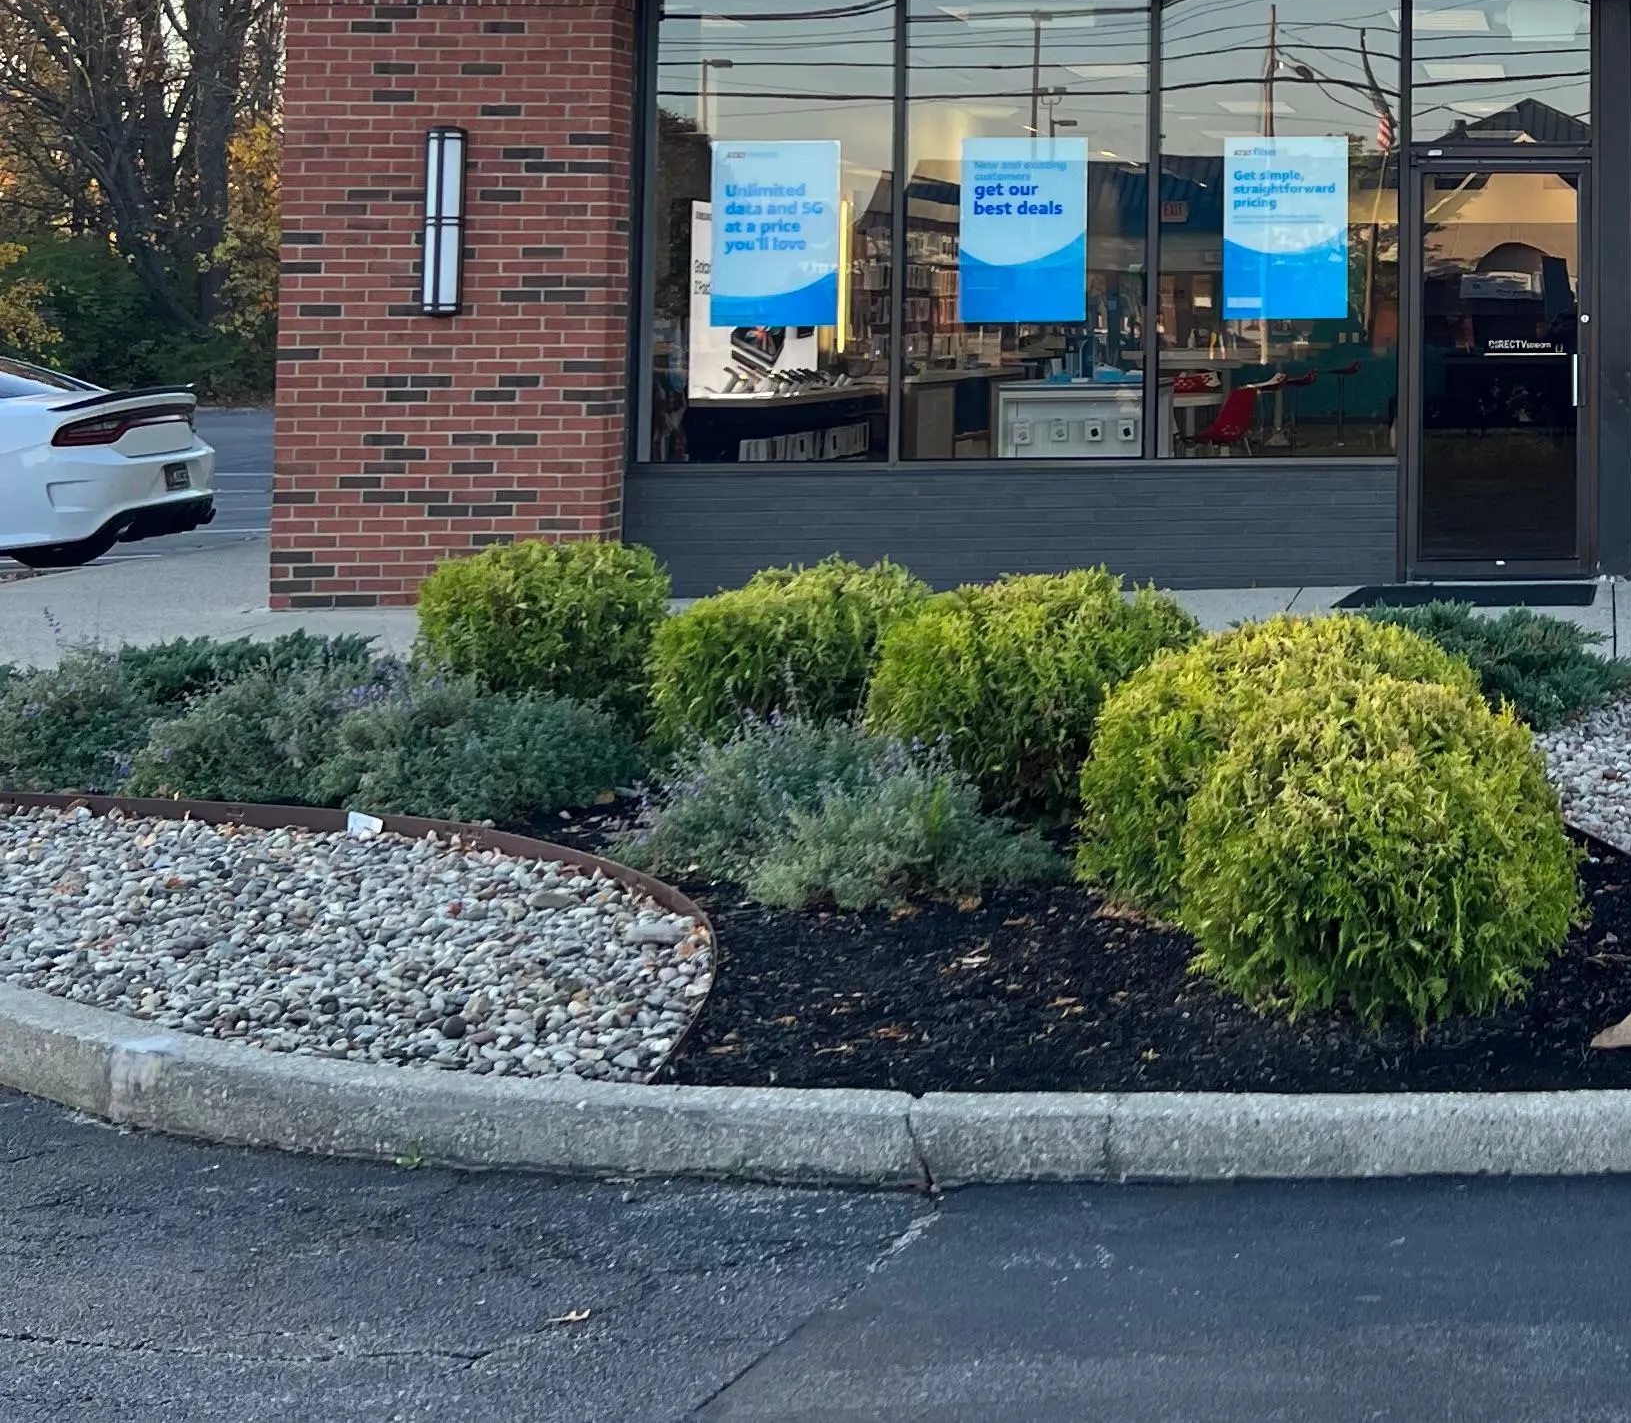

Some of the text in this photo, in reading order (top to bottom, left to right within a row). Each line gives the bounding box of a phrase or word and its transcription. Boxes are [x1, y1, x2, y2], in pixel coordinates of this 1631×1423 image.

[1233, 170, 1304, 183] Get simple,
[725, 183, 805, 198] Unlimited
[974, 184, 1039, 199] get our
[1233, 183, 1336, 196] straightforward
[725, 202, 762, 215] data
[767, 202, 798, 215] and
[974, 201, 1063, 215] best deals
[1233, 198, 1277, 210] pricing
[724, 219, 801, 236] at a price
[724, 237, 806, 255] you'll love
